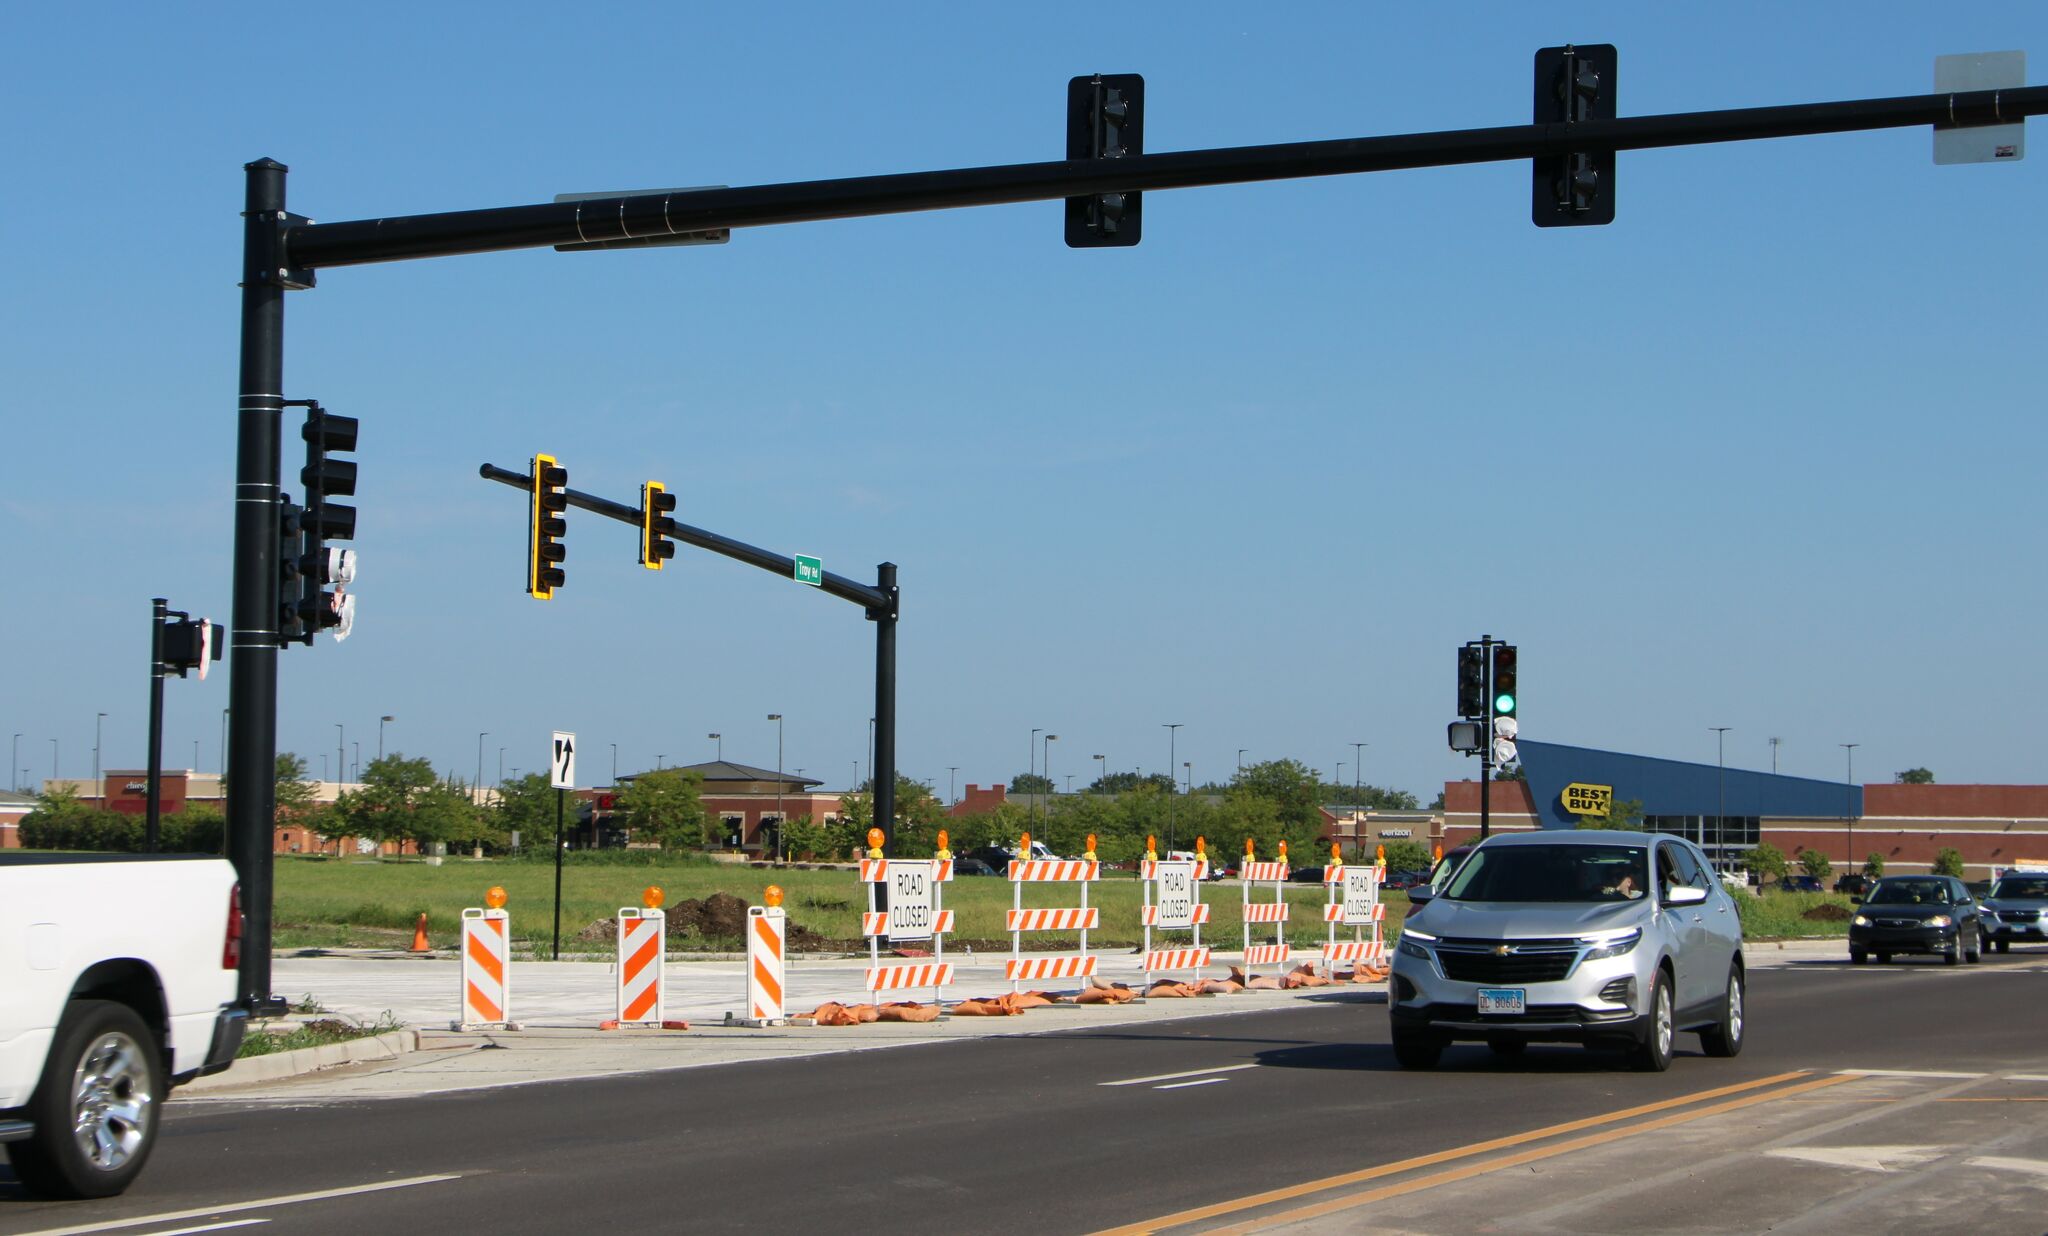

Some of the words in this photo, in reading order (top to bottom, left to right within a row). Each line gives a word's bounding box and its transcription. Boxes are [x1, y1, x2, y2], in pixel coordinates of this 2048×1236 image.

[799, 561, 811, 580] Troy
[1569, 788, 1610, 799] BEST
[1570, 799, 1604, 810] BUY
[1381, 828, 1412, 837] verizon
[897, 873, 923, 896] ROAD
[1164, 873, 1185, 892] ROAD
[1351, 876, 1368, 892] ROAD
[1162, 899, 1189, 918] CLOSED
[1347, 899, 1371, 915] CLOSED
[893, 905, 928, 928] CLOSED
